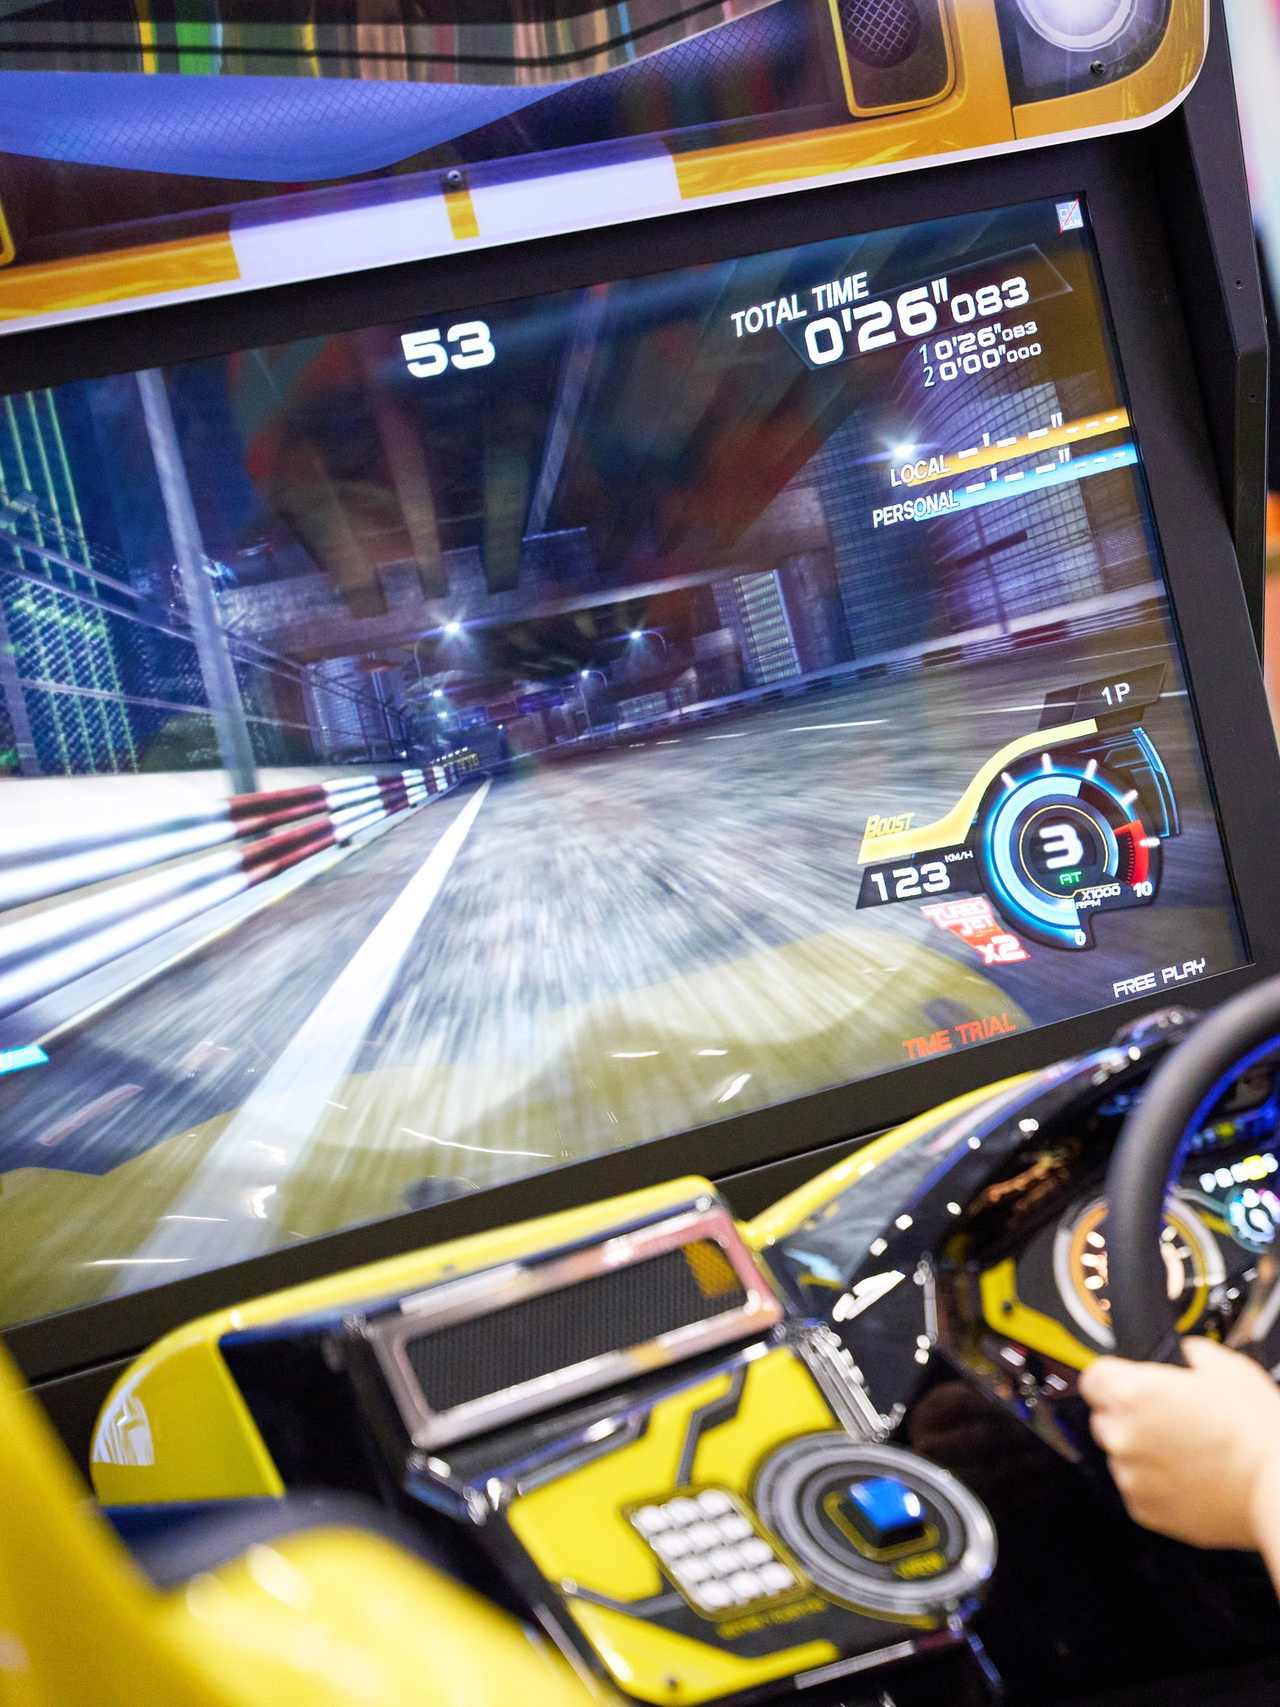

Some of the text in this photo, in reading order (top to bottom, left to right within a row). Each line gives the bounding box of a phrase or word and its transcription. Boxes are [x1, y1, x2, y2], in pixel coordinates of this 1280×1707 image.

[731, 271, 870, 338] TOTAL TIME
[400, 320, 496, 378] 53
[919, 343, 928, 365] 1
[923, 366, 935, 388] 2
[890, 455, 951, 487] LOCAL
[872, 489, 960, 528] PERSONAL
[1101, 682, 1131, 706] 1P
[1039, 823, 1084, 869] 3
[871, 850, 974, 902] 123 KM/H
[1060, 871, 1082, 885] AT
[1133, 881, 1153, 898] 10
[920, 897, 991, 925] TURBO
[1075, 899, 1102, 910] RPM
[961, 915, 994, 936] JET
[1075, 931, 1087, 946] 0
[1113, 957, 1206, 998] FREE PLAY
[902, 1012, 1017, 1060] TIME TRIAL
